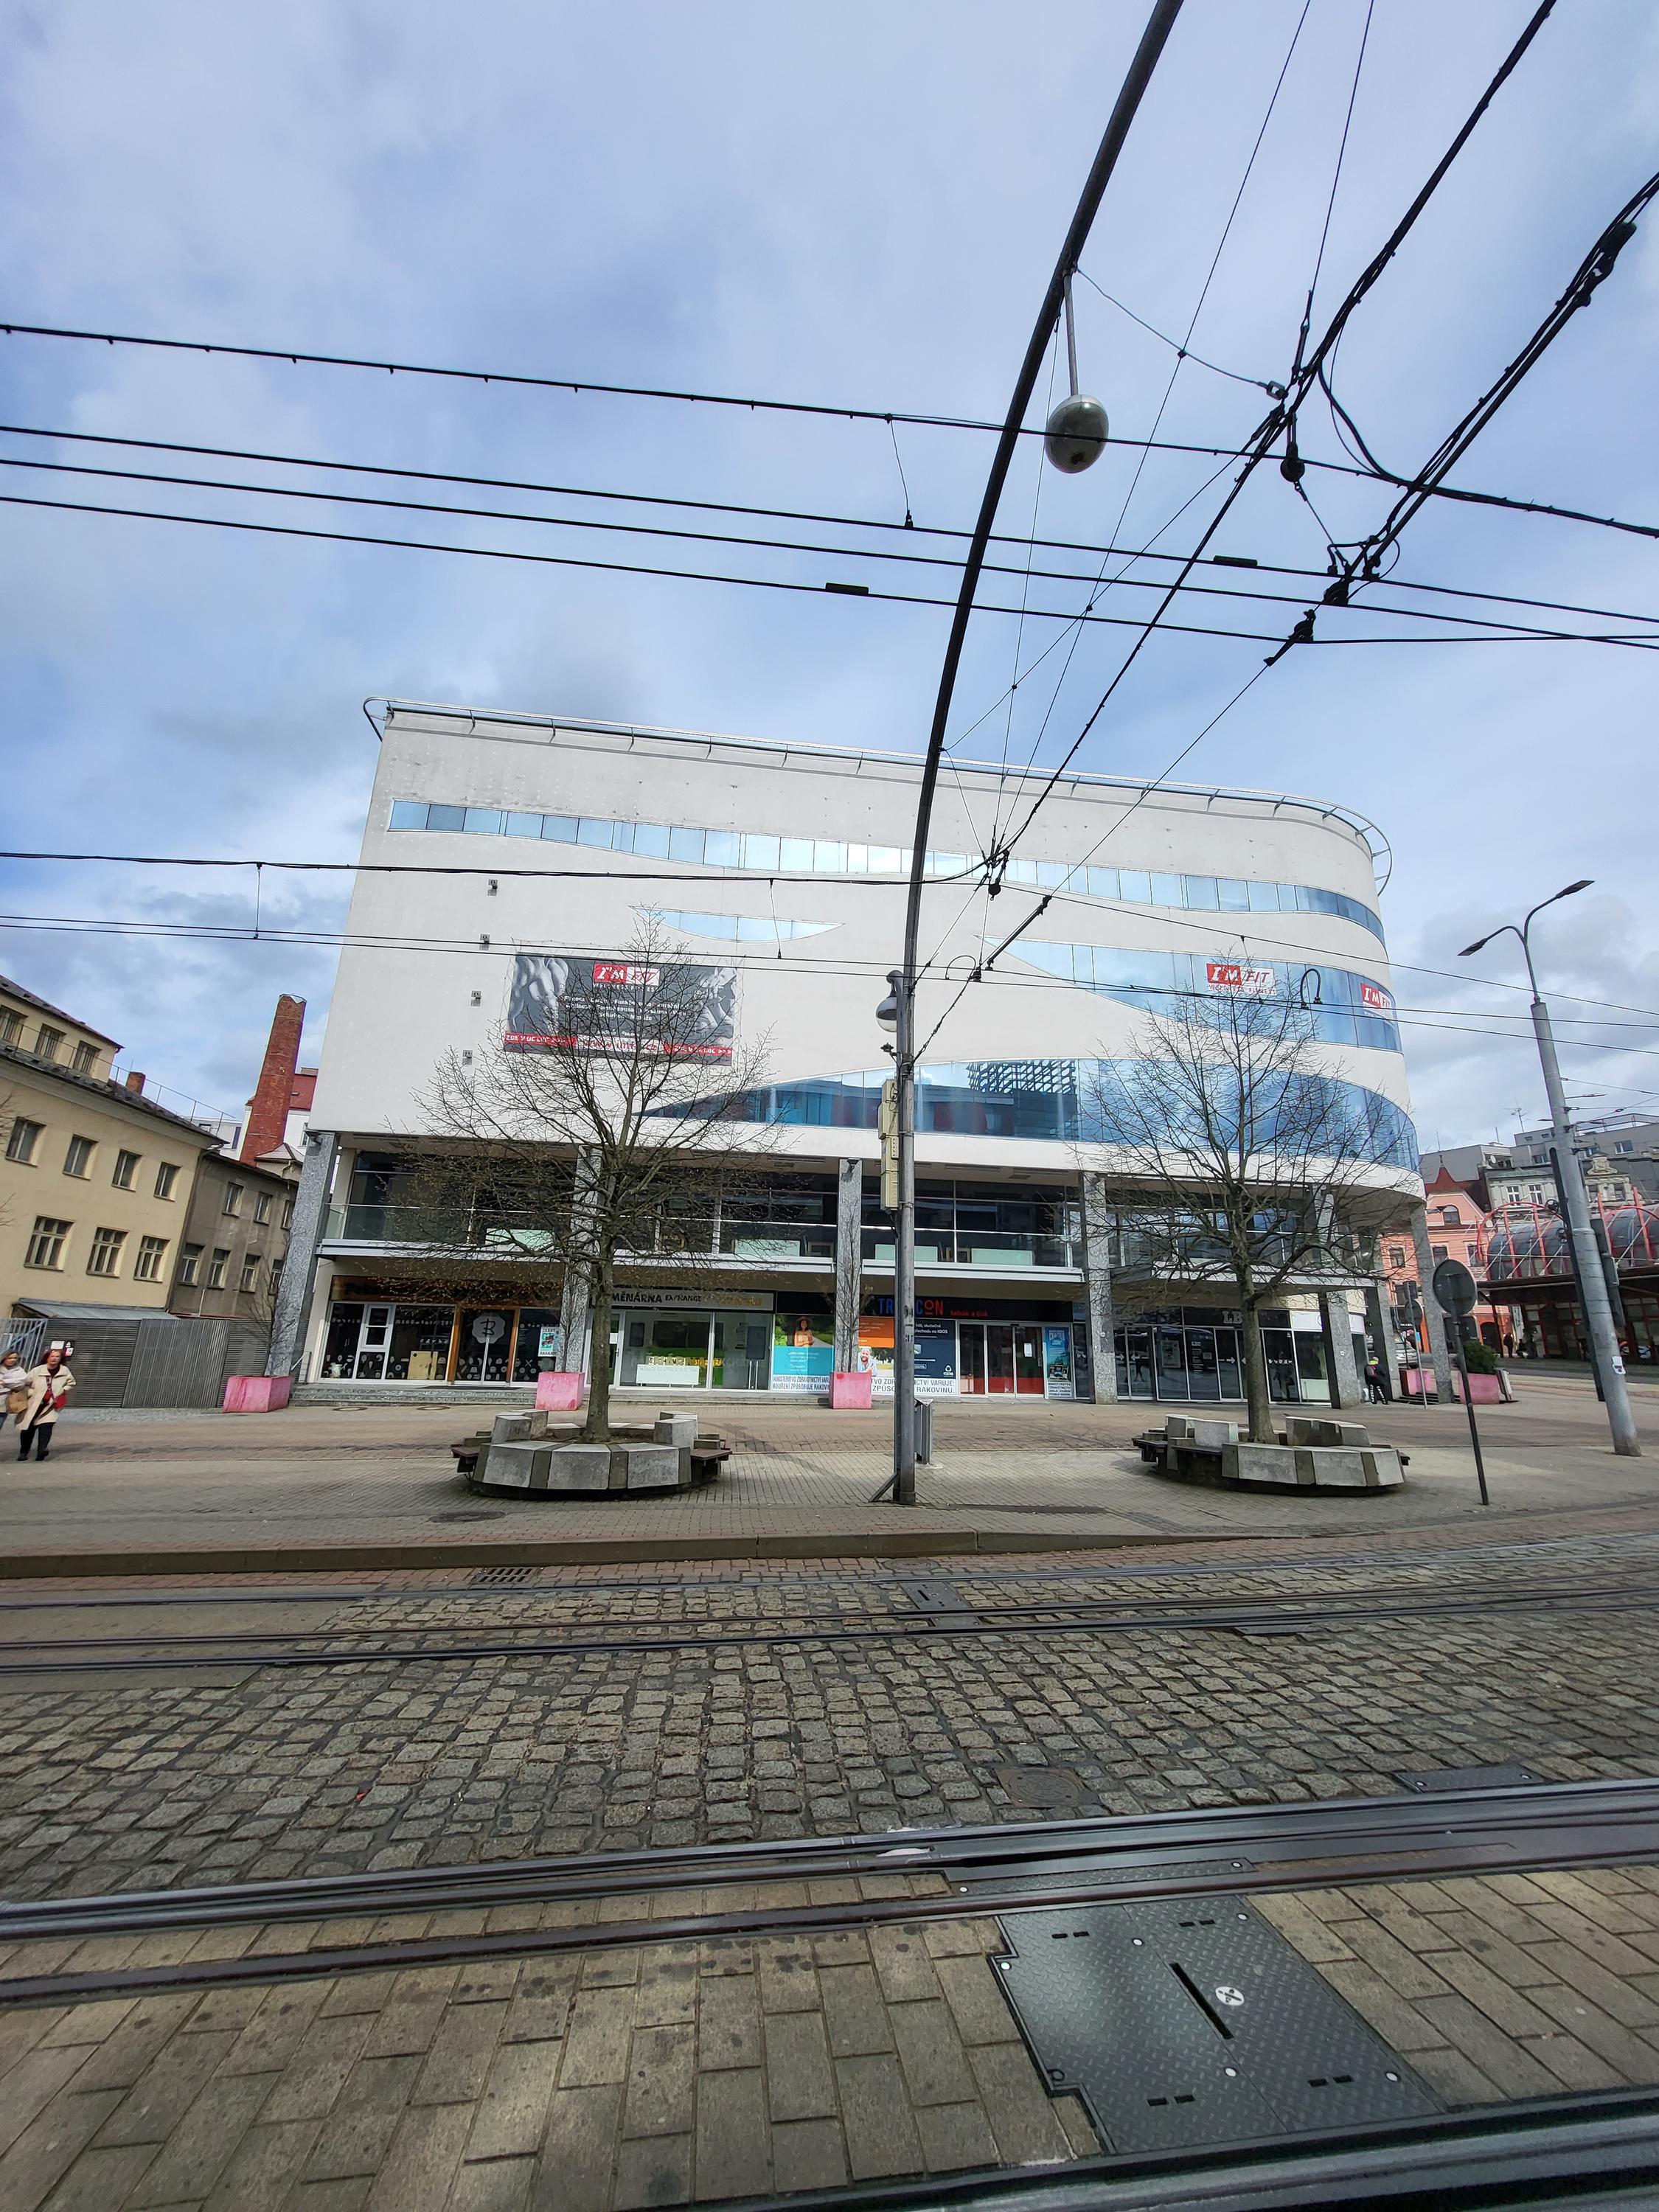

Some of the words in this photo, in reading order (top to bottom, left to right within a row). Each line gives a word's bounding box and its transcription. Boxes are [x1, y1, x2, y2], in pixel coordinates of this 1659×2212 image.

[1211, 967, 1239, 981] I'M
[1245, 970, 1270, 983] FIT
[1364, 987, 1380, 1004] I'M
[613, 1293, 663, 1304] MĚNÁRNA
[878, 1298, 944, 1316] TRCON
